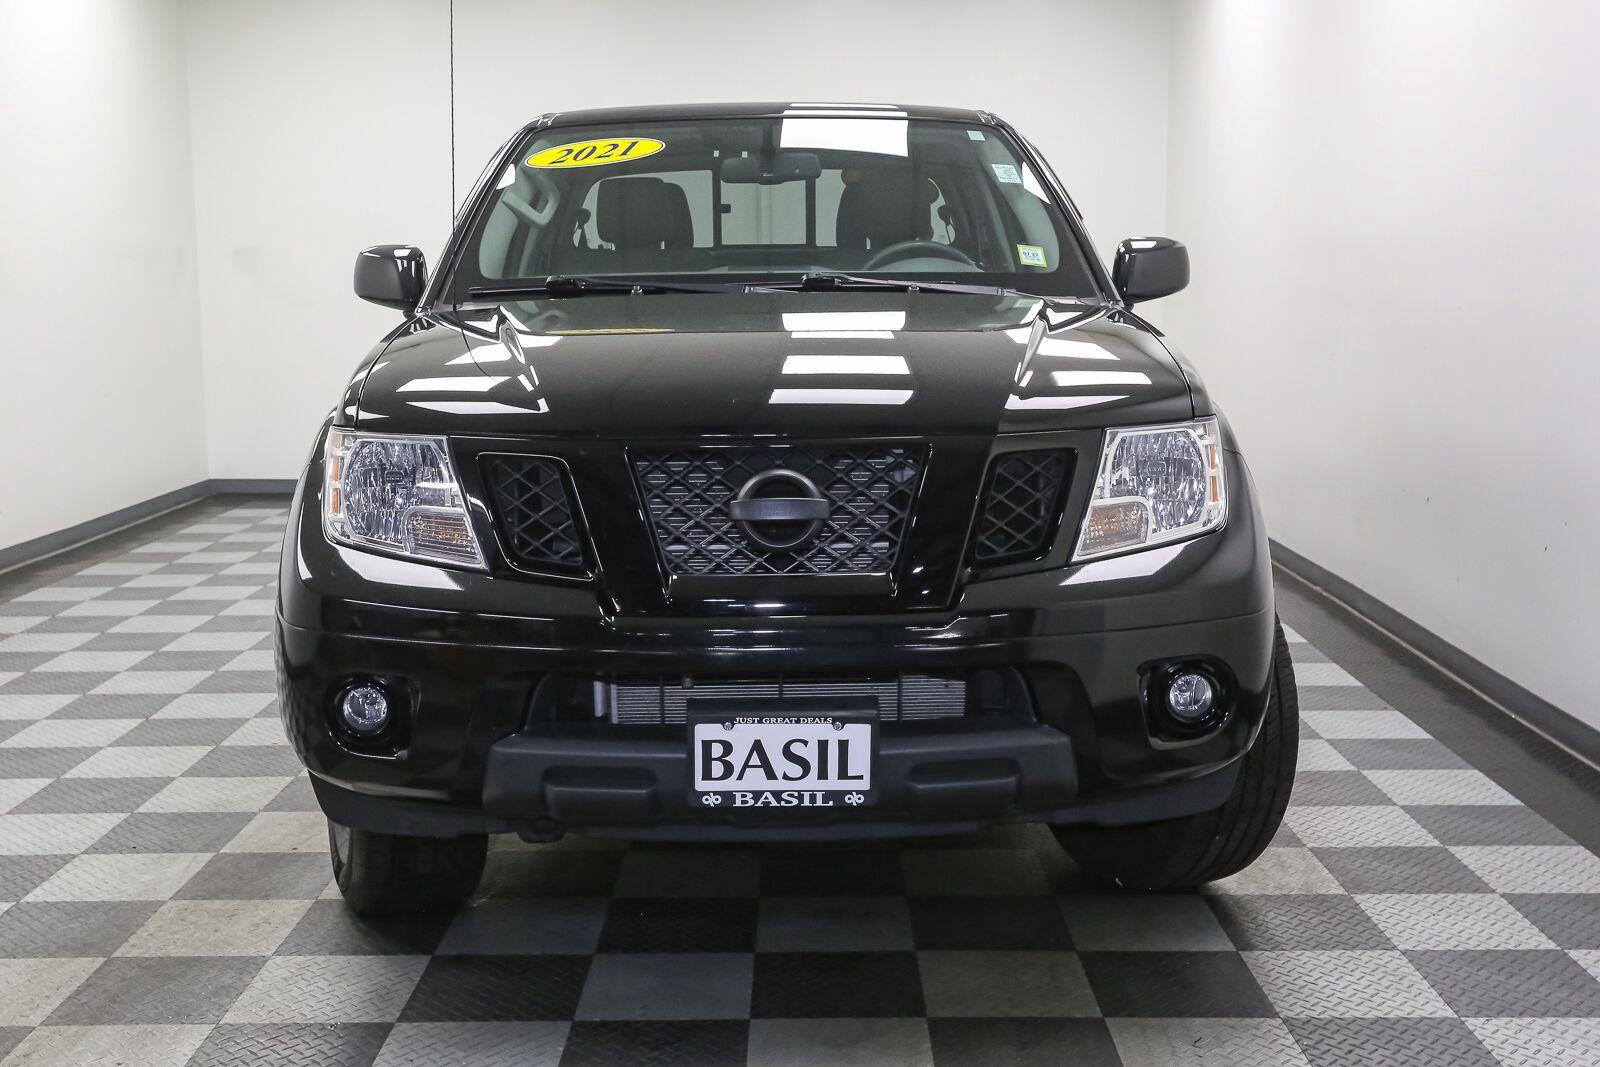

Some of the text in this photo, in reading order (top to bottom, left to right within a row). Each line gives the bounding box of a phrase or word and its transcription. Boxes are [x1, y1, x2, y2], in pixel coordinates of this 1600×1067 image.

[548, 140, 640, 165] 2021
[701, 738, 864, 781] BASIL
[732, 791, 834, 807] BASIL
